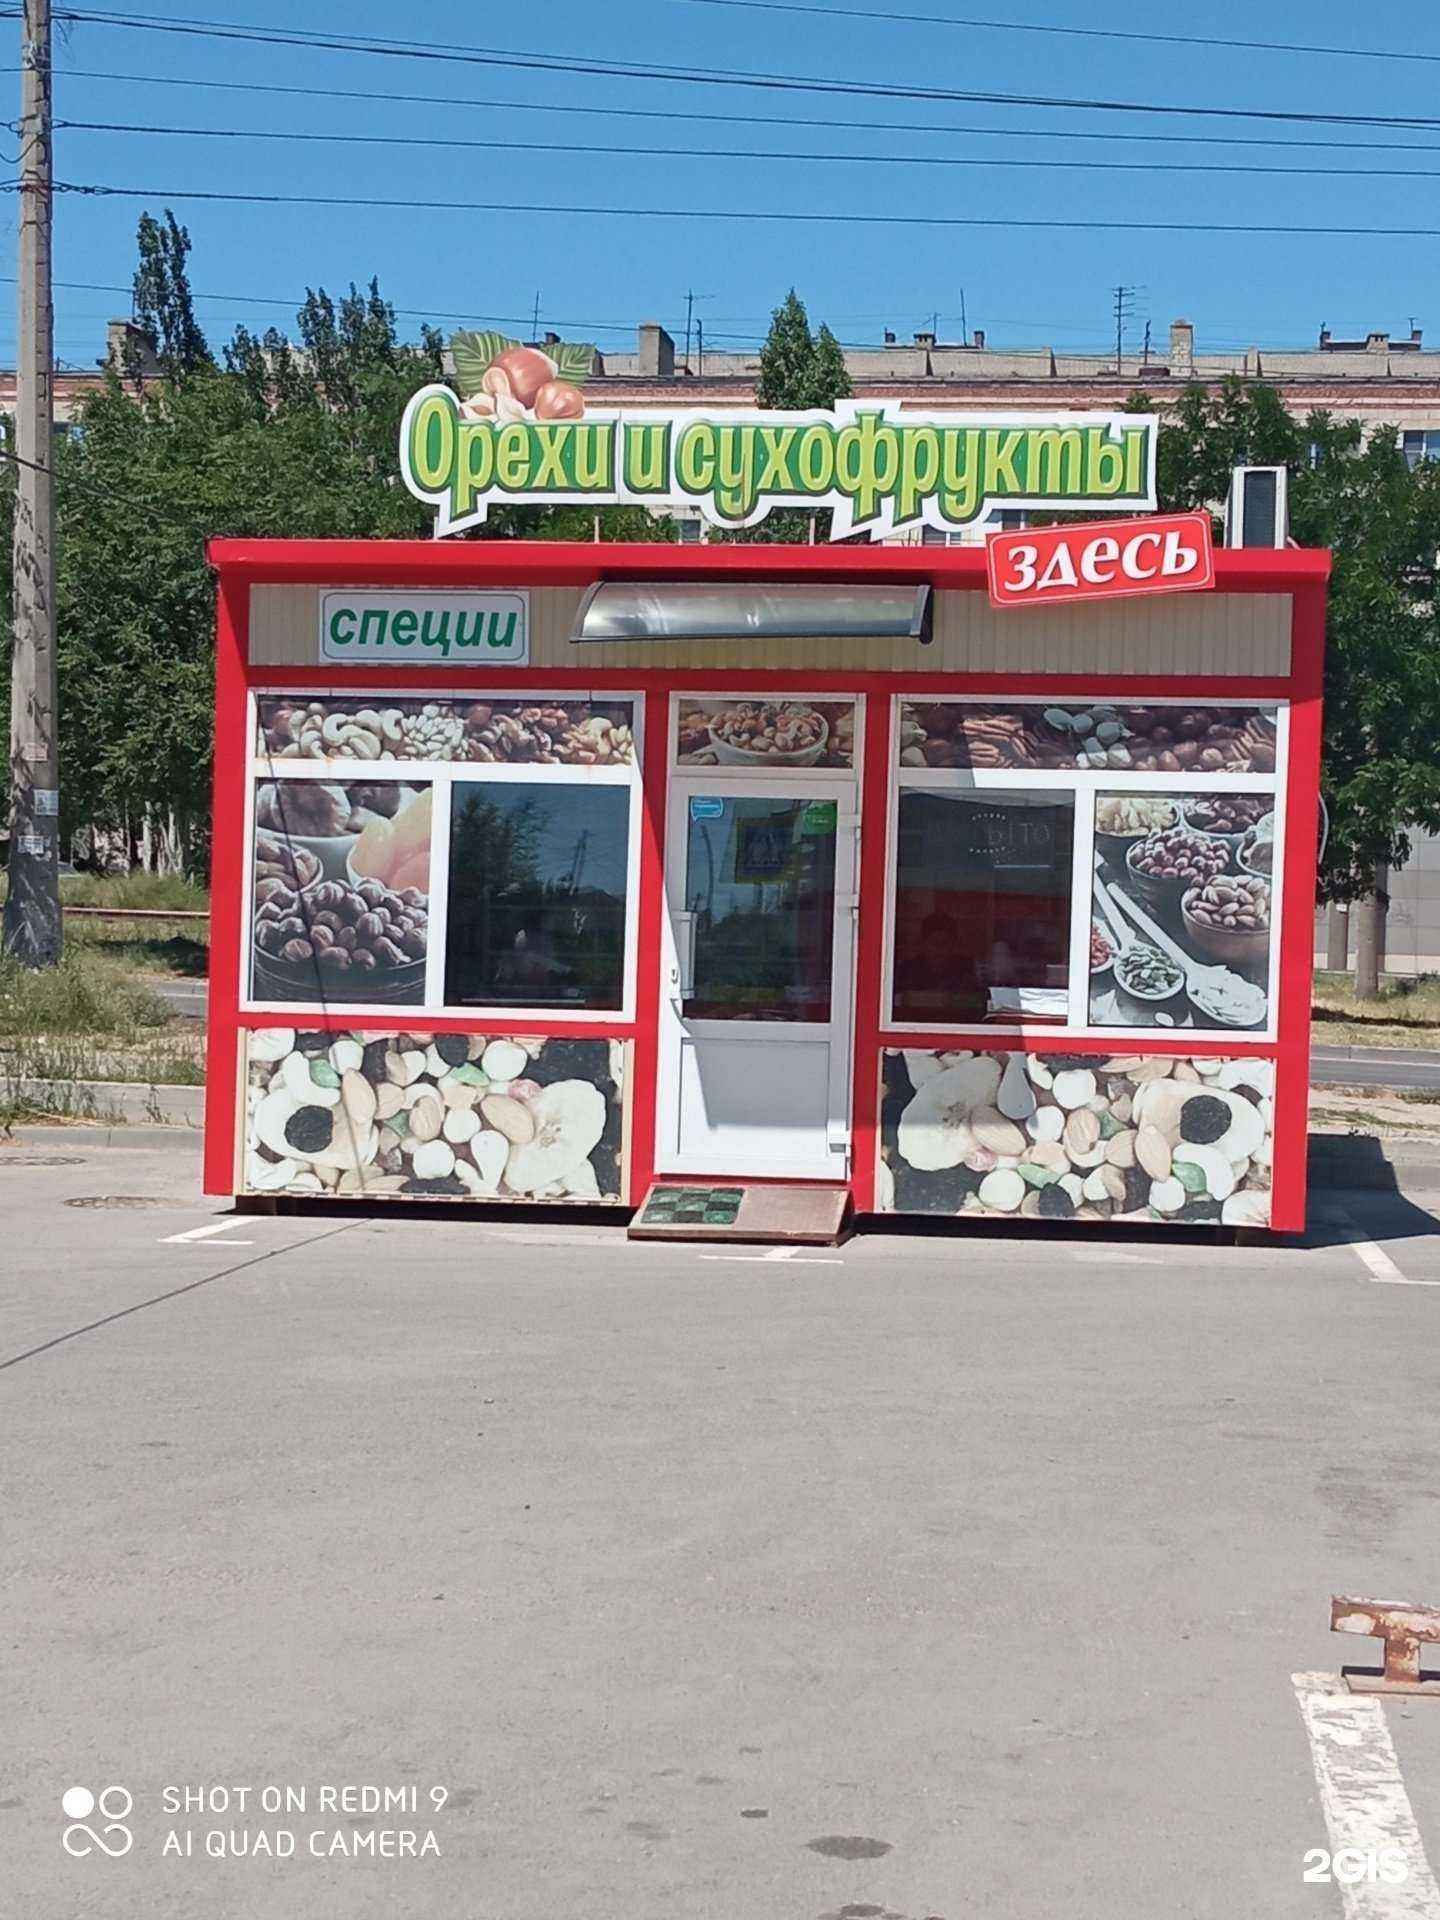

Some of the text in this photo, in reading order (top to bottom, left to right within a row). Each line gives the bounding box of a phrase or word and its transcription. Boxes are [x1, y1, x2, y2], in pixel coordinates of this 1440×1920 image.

[413, 394, 1148, 521] Орехи и сухофрукты
[329, 608, 518, 657] специи
